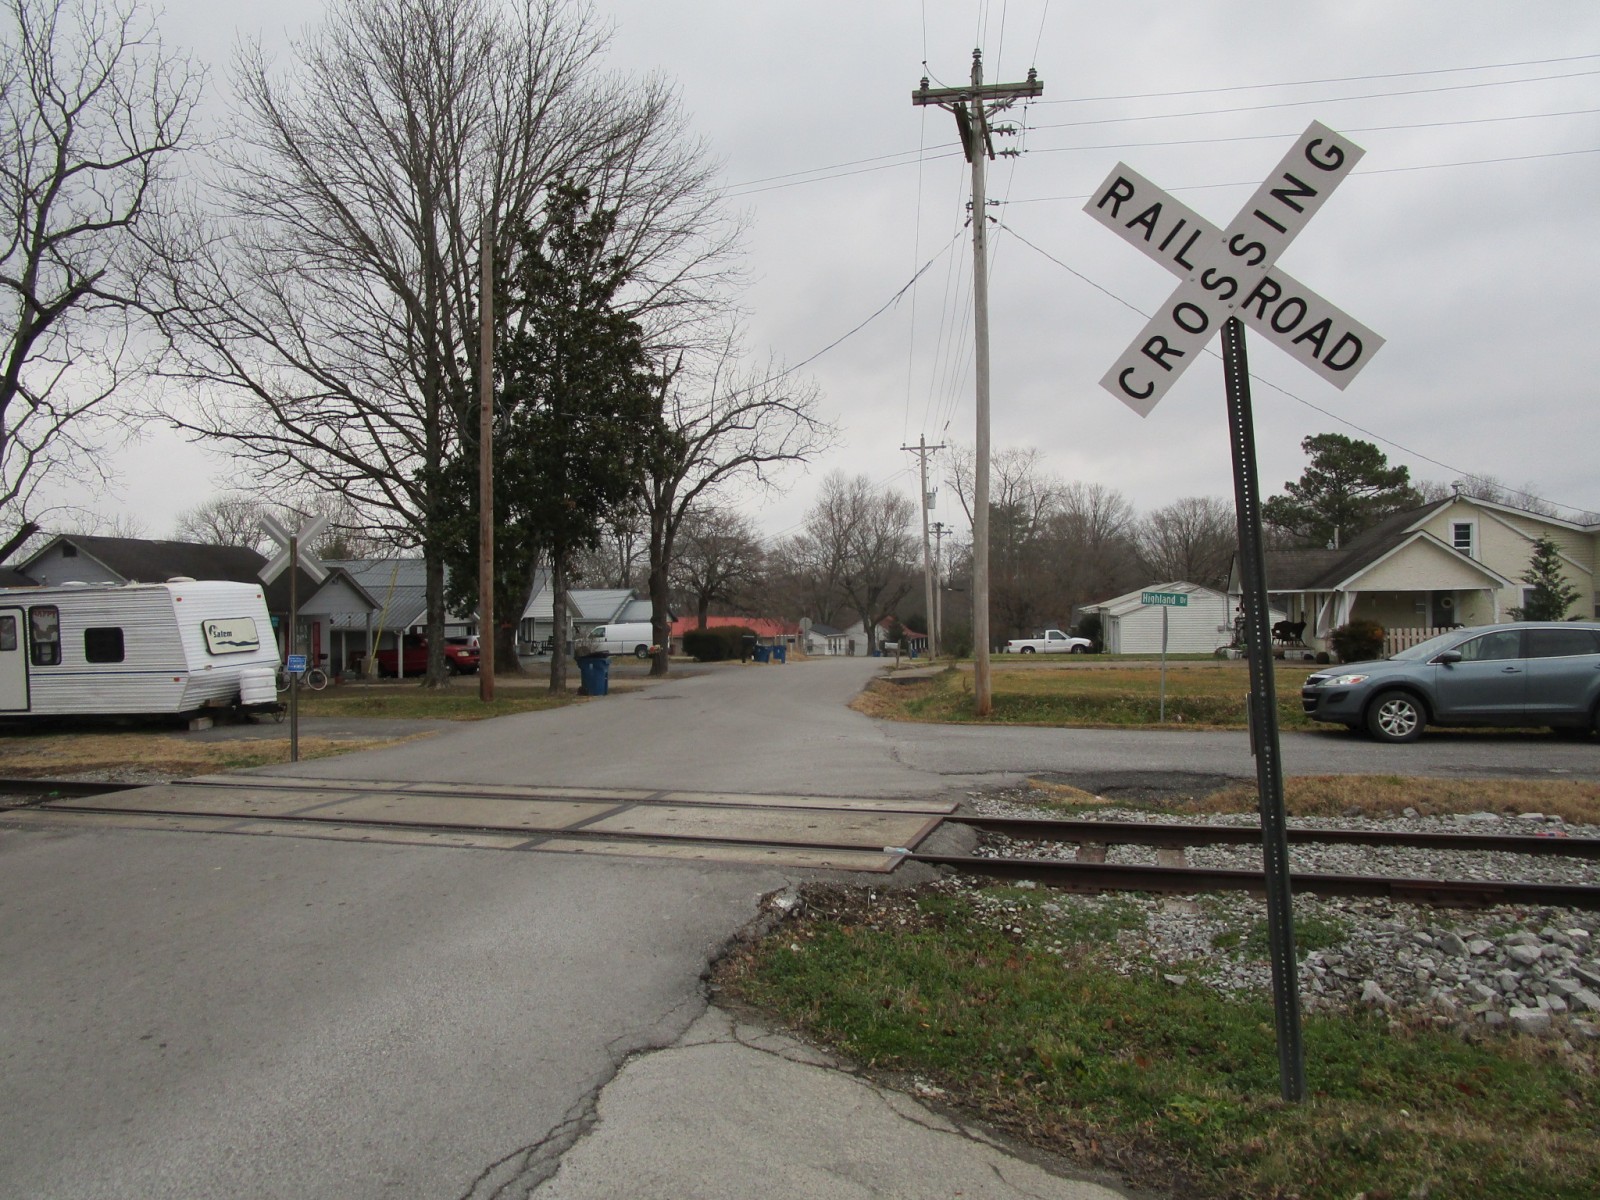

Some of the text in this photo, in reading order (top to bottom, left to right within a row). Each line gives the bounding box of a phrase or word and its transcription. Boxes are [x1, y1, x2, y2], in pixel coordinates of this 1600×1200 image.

[1097, 176, 1363, 372] RAIL ROAD
[1118, 138, 1345, 399] CROSSING
[213, 630, 233, 638] Salem
[1142, 593, 1187, 605] Highland Dr
